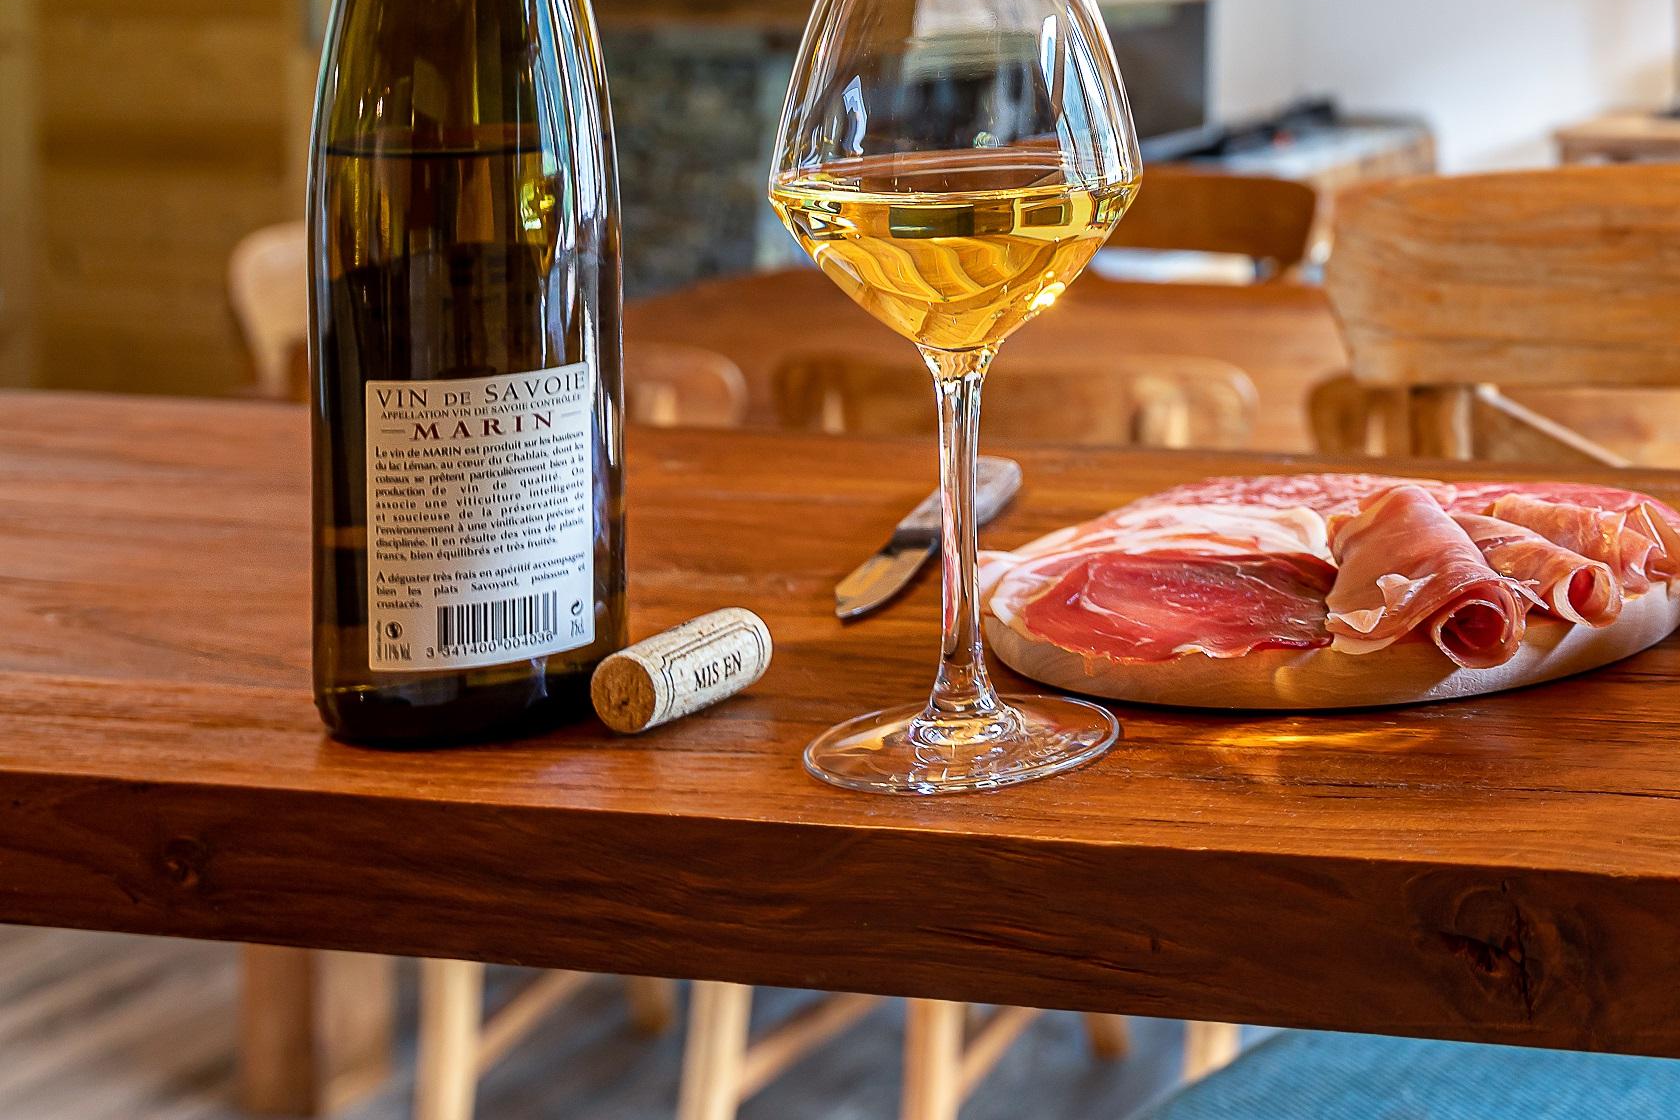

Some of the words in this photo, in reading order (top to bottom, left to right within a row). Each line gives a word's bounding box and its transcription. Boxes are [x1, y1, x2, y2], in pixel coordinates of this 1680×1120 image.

[376, 388, 428, 408] VIN
[444, 392, 471, 406] DE
[485, 371, 585, 404] SAVOIE
[381, 408, 449, 420] APPELLATION
[452, 407, 472, 417] VIN
[474, 405, 488, 416] DE
[491, 401, 528, 415] SAVOIE
[409, 411, 553, 440] MARIN
[376, 446, 388, 457] Le
[389, 447, 404, 458] vin
[407, 448, 420, 457] de
[423, 446, 461, 457] MARIN
[464, 445, 480, 456] est
[483, 439, 521, 457] produit
[524, 440, 537, 448] sur
[376, 460, 387, 470] du
[389, 460, 400, 470] lac
[440, 460, 453, 469] au
[457, 459, 484, 469] cœur
[488, 455, 502, 466] du
[414, 475, 425, 483] se
[470, 462, 546, 483] particulièrement
[376, 487, 426, 498] production
[432, 485, 447, 495] de
[461, 484, 479, 494] vin
[493, 480, 507, 490] de
[376, 500, 416, 509] associe
[425, 499, 447, 509] une
[457, 492, 521, 507] viticulture
[376, 512, 386, 522] et
[393, 511, 450, 522] soucieuse
[459, 509, 473, 519] de
[482, 507, 492, 517] la
[501, 496, 568, 518] préservation
[458, 521, 464, 532] à
[467, 522, 487, 532] une
[490, 513, 543, 529] vinification
[431, 536, 438, 547] Il
[442, 536, 455, 546] en
[460, 531, 496, 546] résulte
[500, 529, 518, 539] des
[522, 526, 541, 536] vins
[410, 550, 433, 560] bien
[437, 546, 490, 561] équilibrés
[494, 544, 503, 554] et
[506, 541, 525, 552] très
[376, 571, 385, 584] A
[388, 572, 430, 585] déguster
[433, 572, 452, 582] très
[455, 569, 477, 581] frais
[479, 569, 492, 579] en
[495, 562, 531, 578] apéritif
[376, 584, 397, 596] bien
[408, 585, 422, 596] les
[434, 584, 458, 598] plats
[694, 661, 719, 691] MIS
[723, 650, 742, 680] EN
